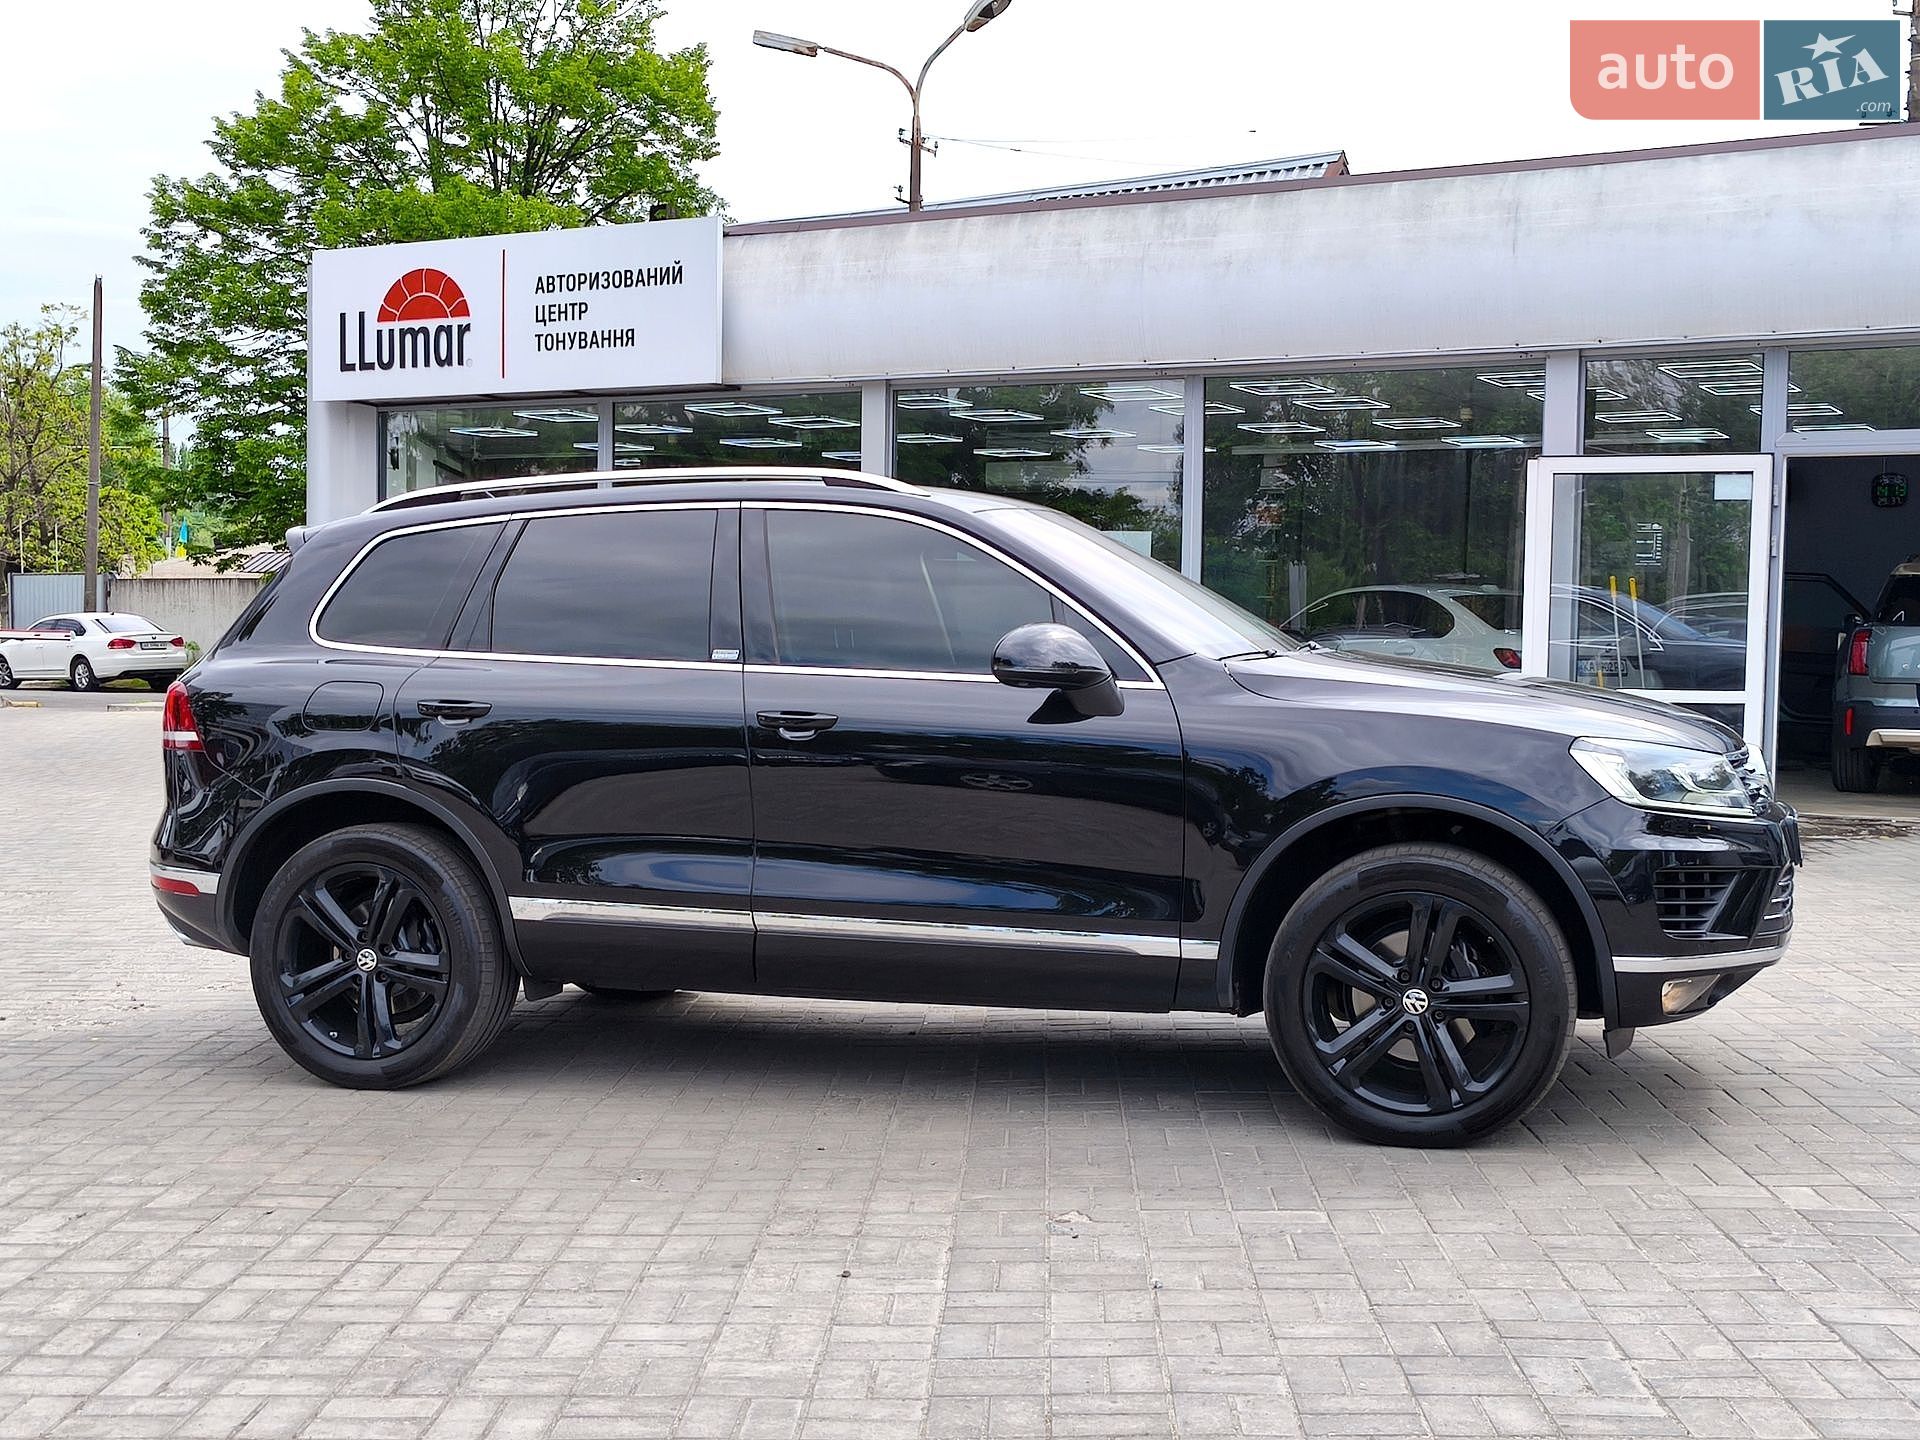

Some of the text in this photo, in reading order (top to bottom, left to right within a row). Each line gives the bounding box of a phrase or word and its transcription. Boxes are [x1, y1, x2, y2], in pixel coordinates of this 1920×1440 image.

[535, 260, 683, 294] АВТОРИЗОВАНИЙ
[535, 302, 588, 326] ЦЕНТР
[340, 311, 471, 372] LLumar
[534, 328, 635, 352] ТОНУВАННЯ
